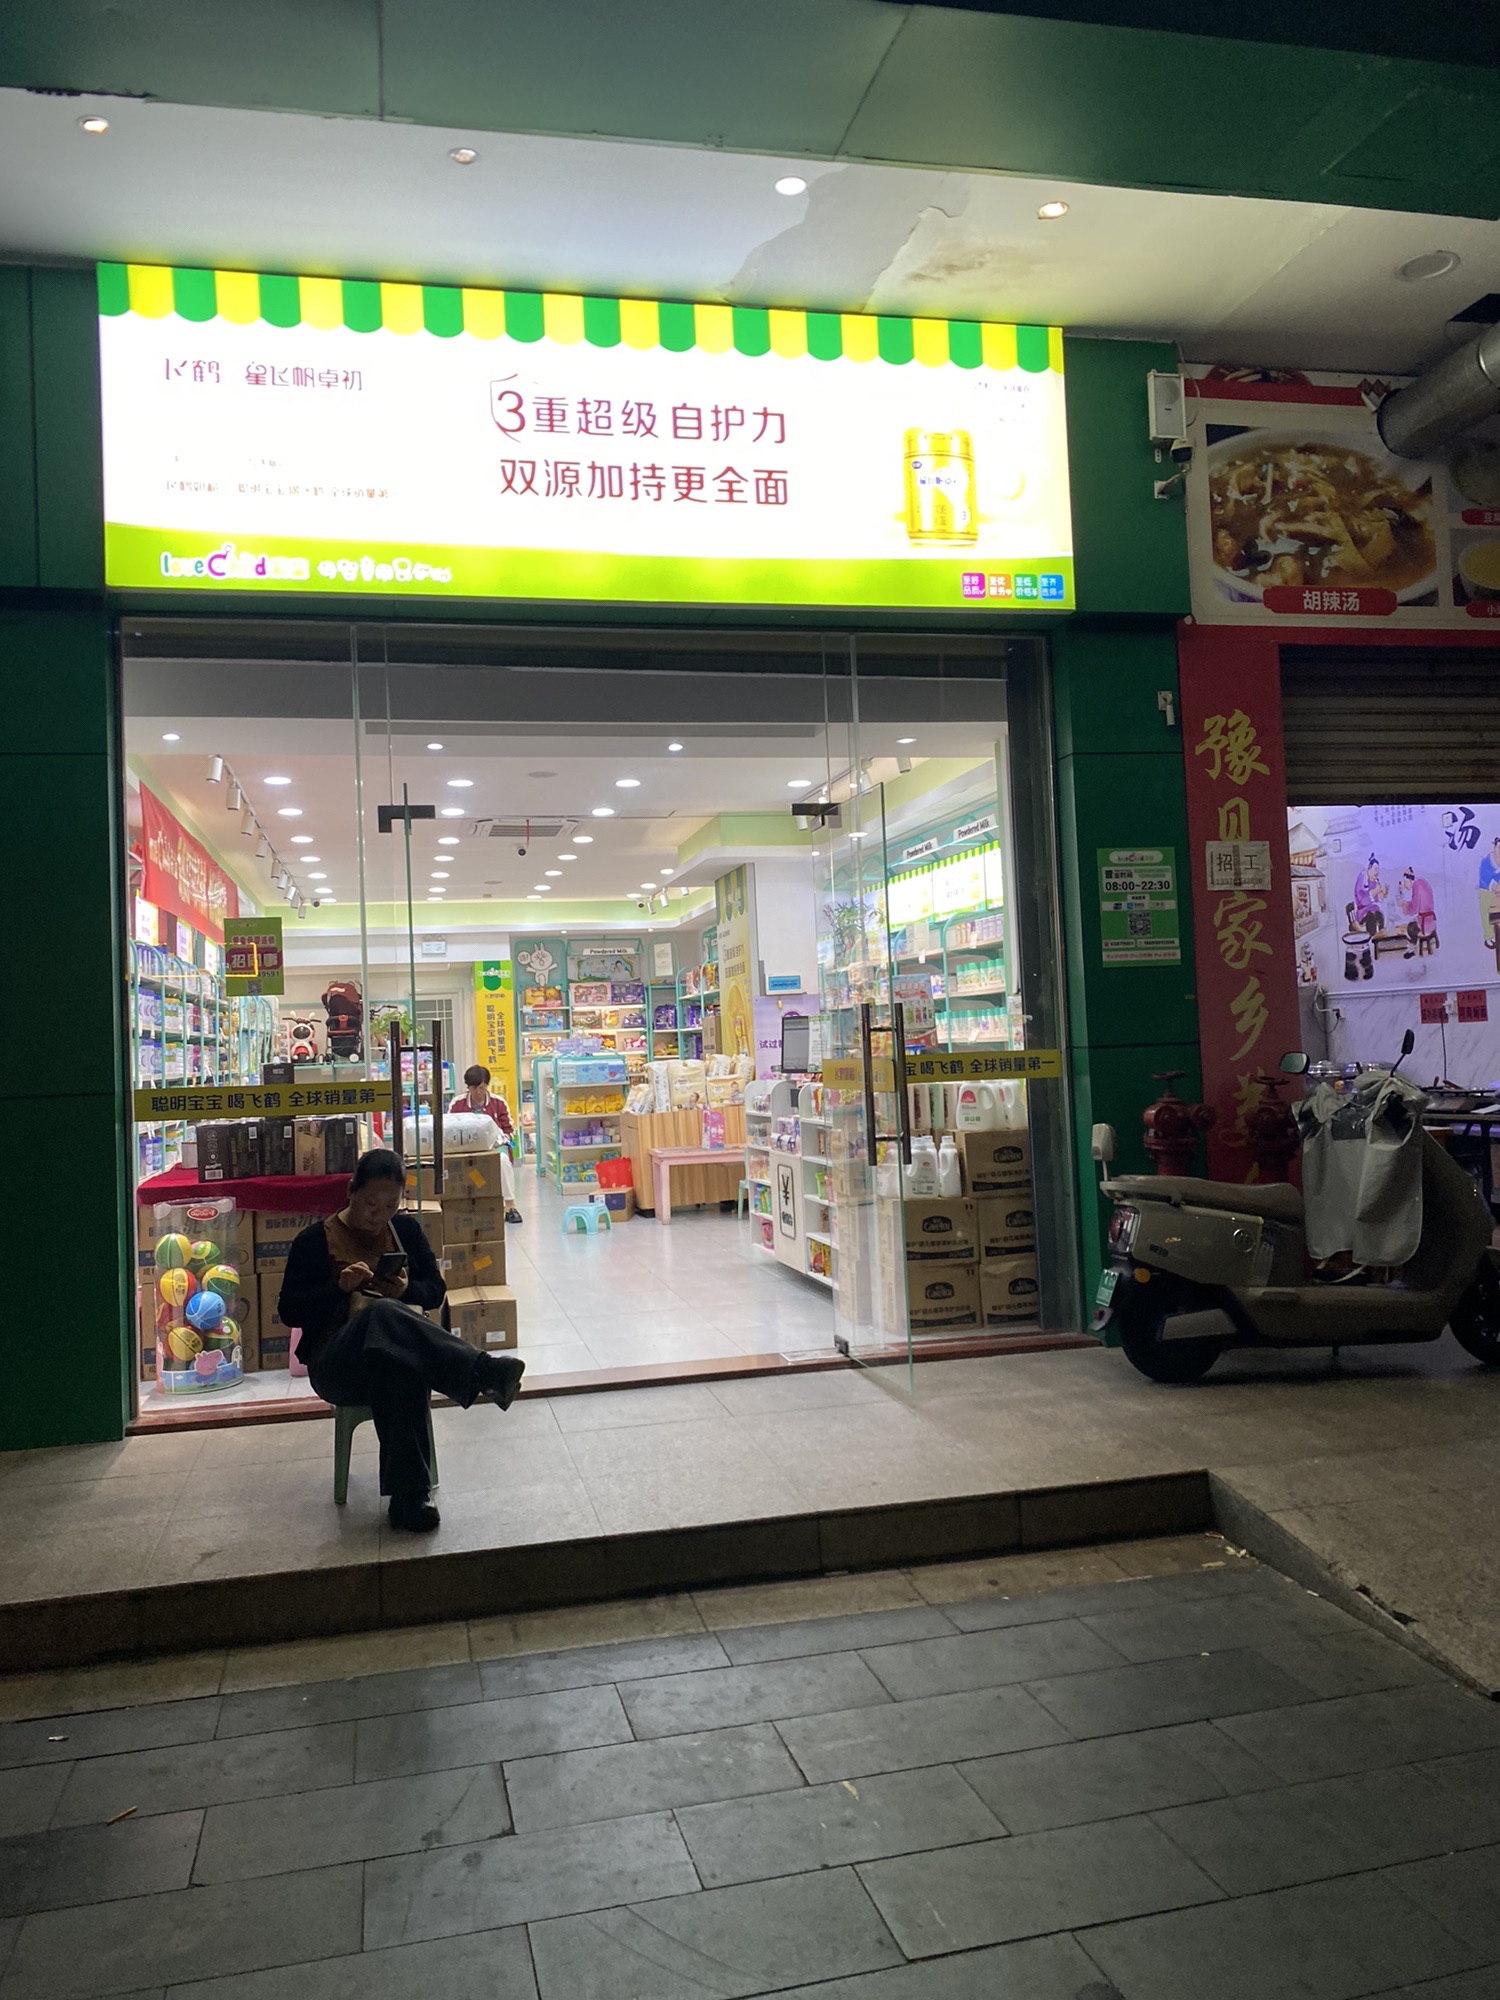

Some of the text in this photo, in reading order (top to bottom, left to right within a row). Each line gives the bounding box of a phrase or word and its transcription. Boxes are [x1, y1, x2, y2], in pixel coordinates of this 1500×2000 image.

[245, 362, 362, 391] 星飞帆卓初
[496, 390, 786, 444] 3重超级自护力
[500, 459, 788, 506] 双源加持更全面
[1302, 590, 1360, 612] 胡辣汤
[957, 818, 990, 839] Powdered Milk
[1441, 806, 1481, 851] 汤
[906, 841, 933, 858] Powdered Milk
[1216, 853, 1261, 872] 招工
[1105, 880, 1170, 891] 08:00~22:30
[920, 1060, 964, 1076] 喝飞鹤
[970, 1056, 1055, 1074] 全球销量第一
[151, 1088, 392, 1112] 聪明宝宝 喝飞鹤 全球销量第一
